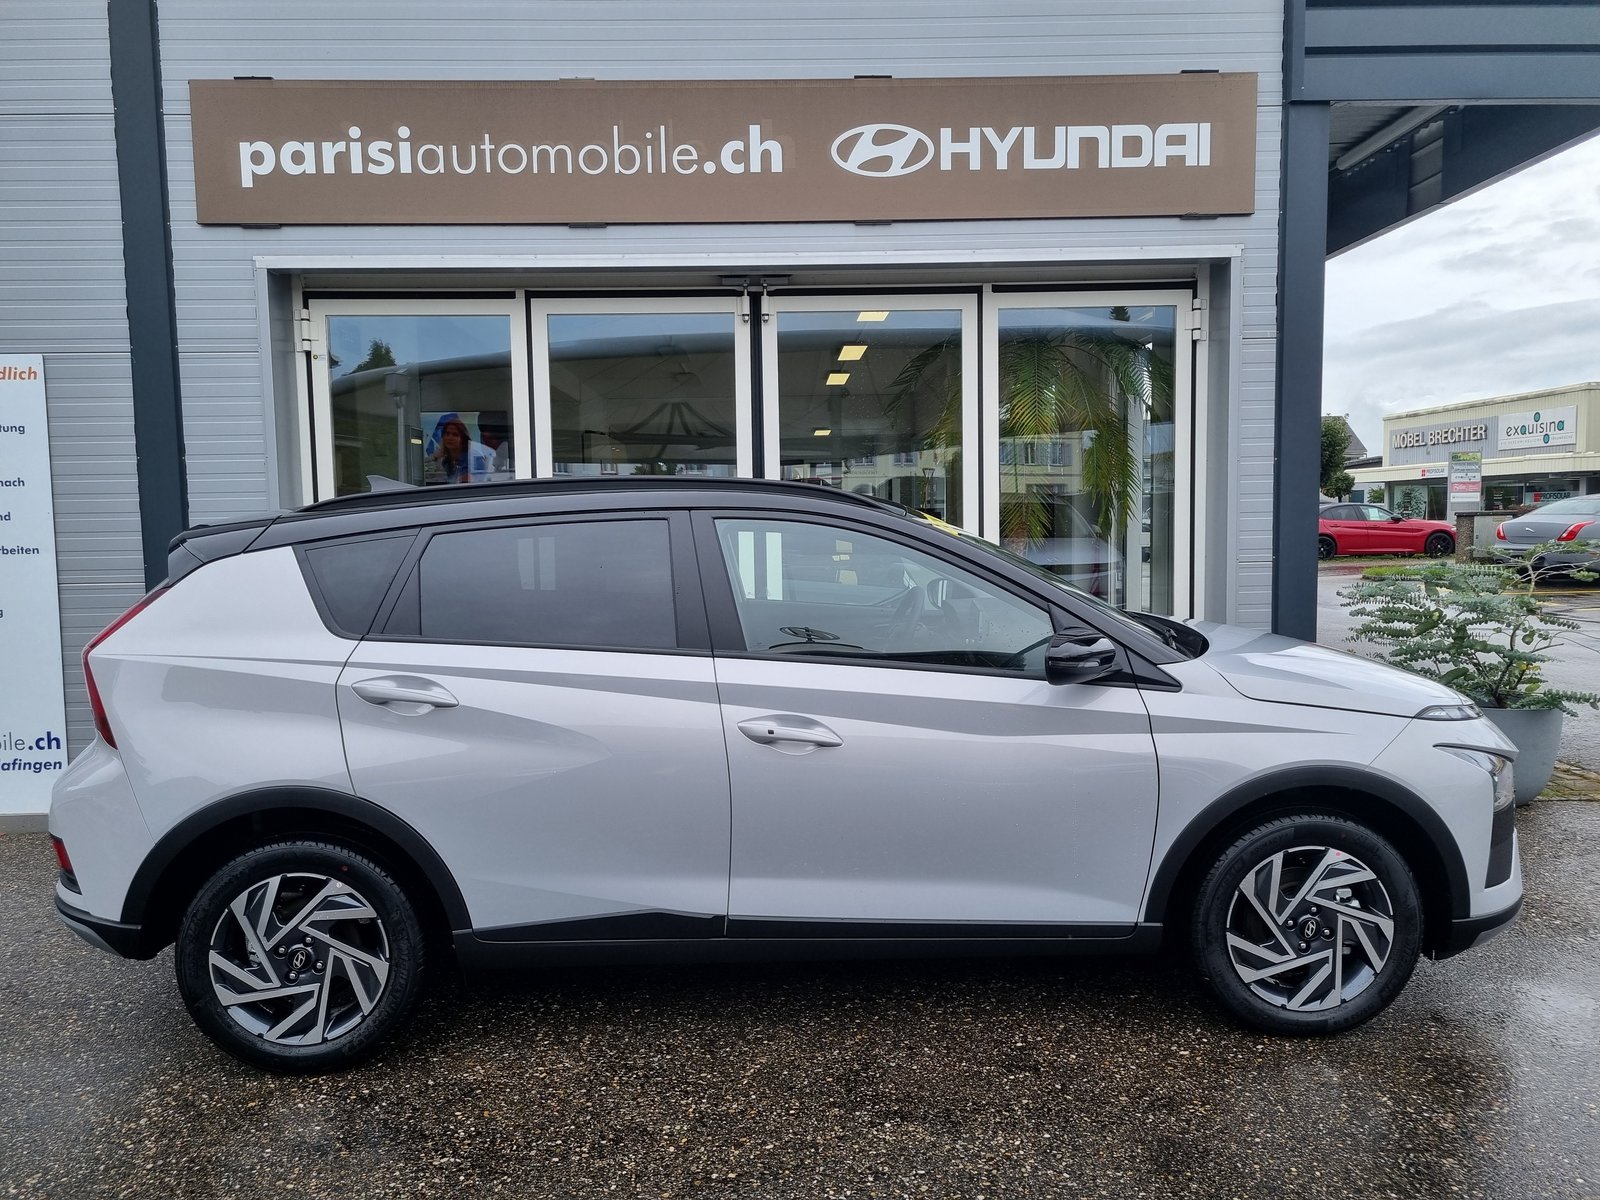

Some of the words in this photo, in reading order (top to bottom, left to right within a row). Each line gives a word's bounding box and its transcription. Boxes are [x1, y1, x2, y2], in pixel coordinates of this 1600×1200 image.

[239, 125, 783, 188] parisiautomobile.ch
[940, 123, 1211, 171] HYUNDAI
[1428, 424, 1488, 445] BRECHTER
[0, 545, 40, 556] beiten
[0, 731, 61, 751] ile.ch
